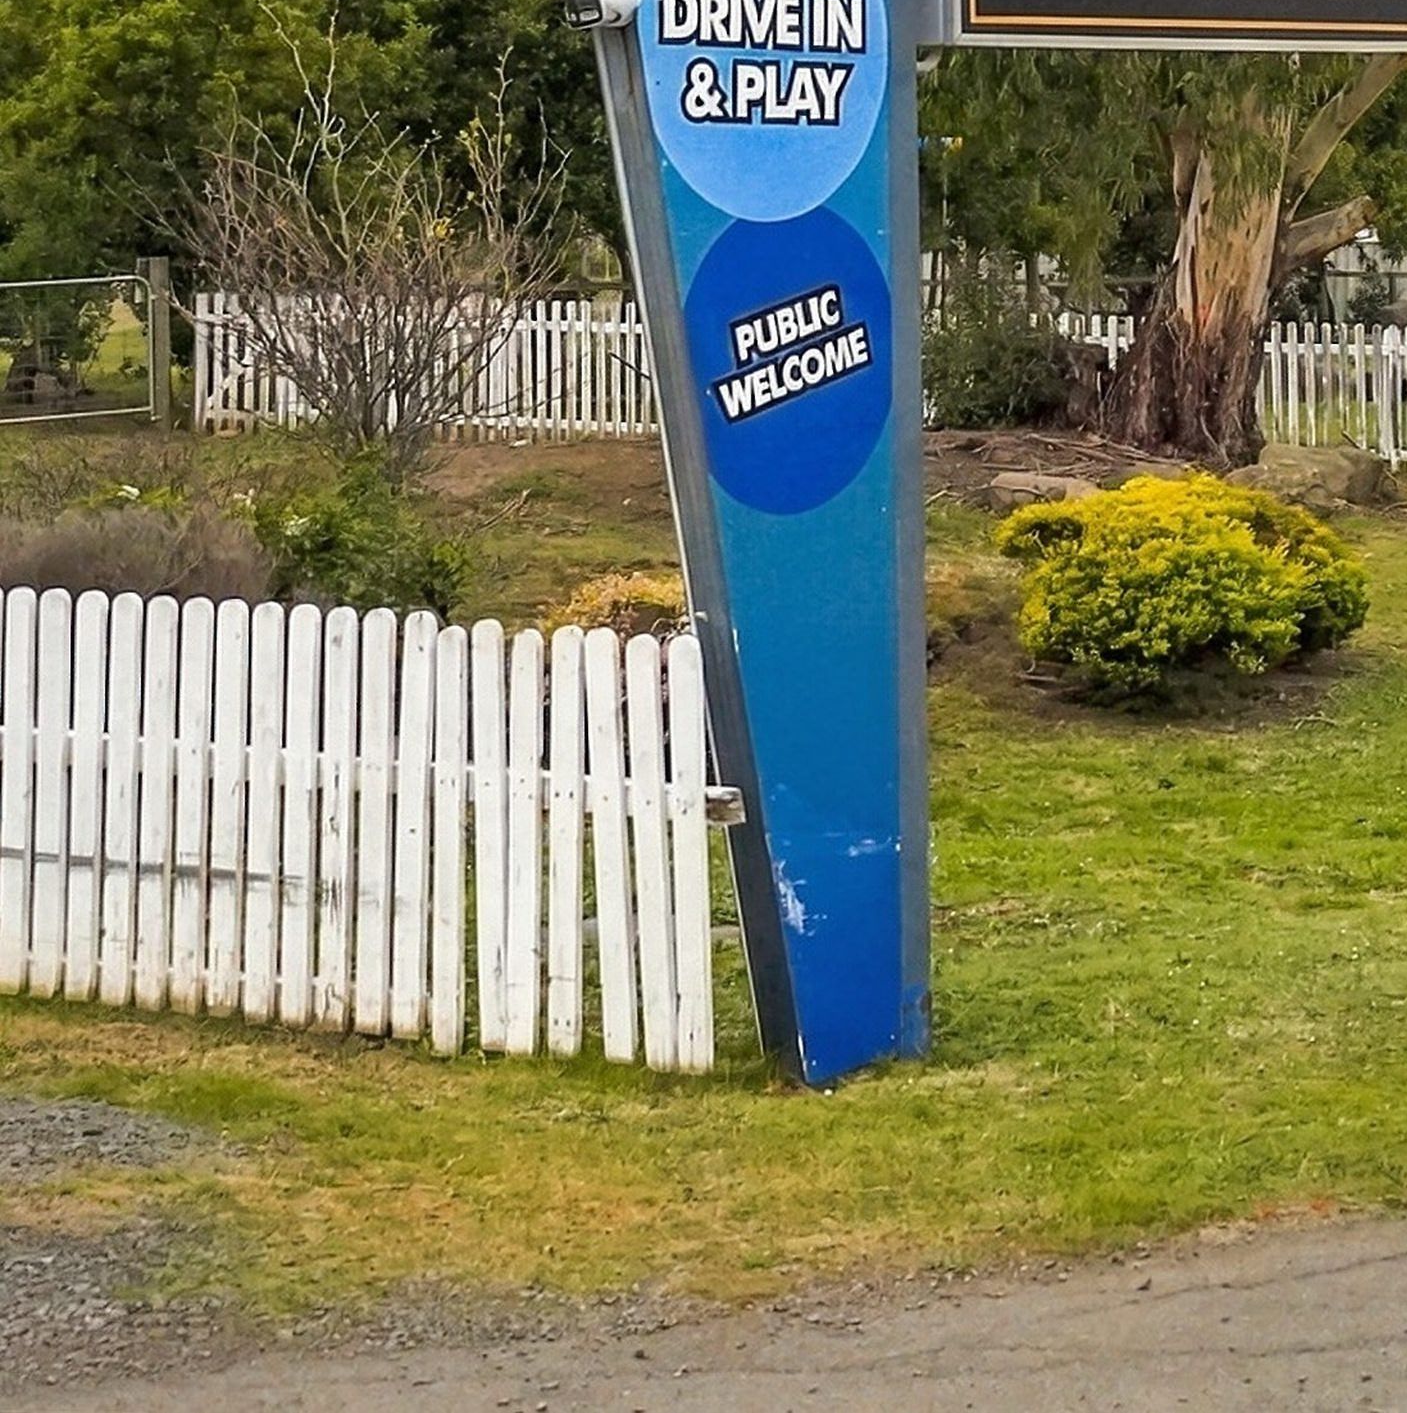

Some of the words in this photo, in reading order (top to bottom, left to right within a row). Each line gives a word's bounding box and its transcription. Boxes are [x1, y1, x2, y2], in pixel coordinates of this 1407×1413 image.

[683, 61, 725, 119] &
[734, 62, 849, 122] PLAY
[732, 288, 841, 363] PUBLIC
[717, 326, 870, 420] WELCOME
